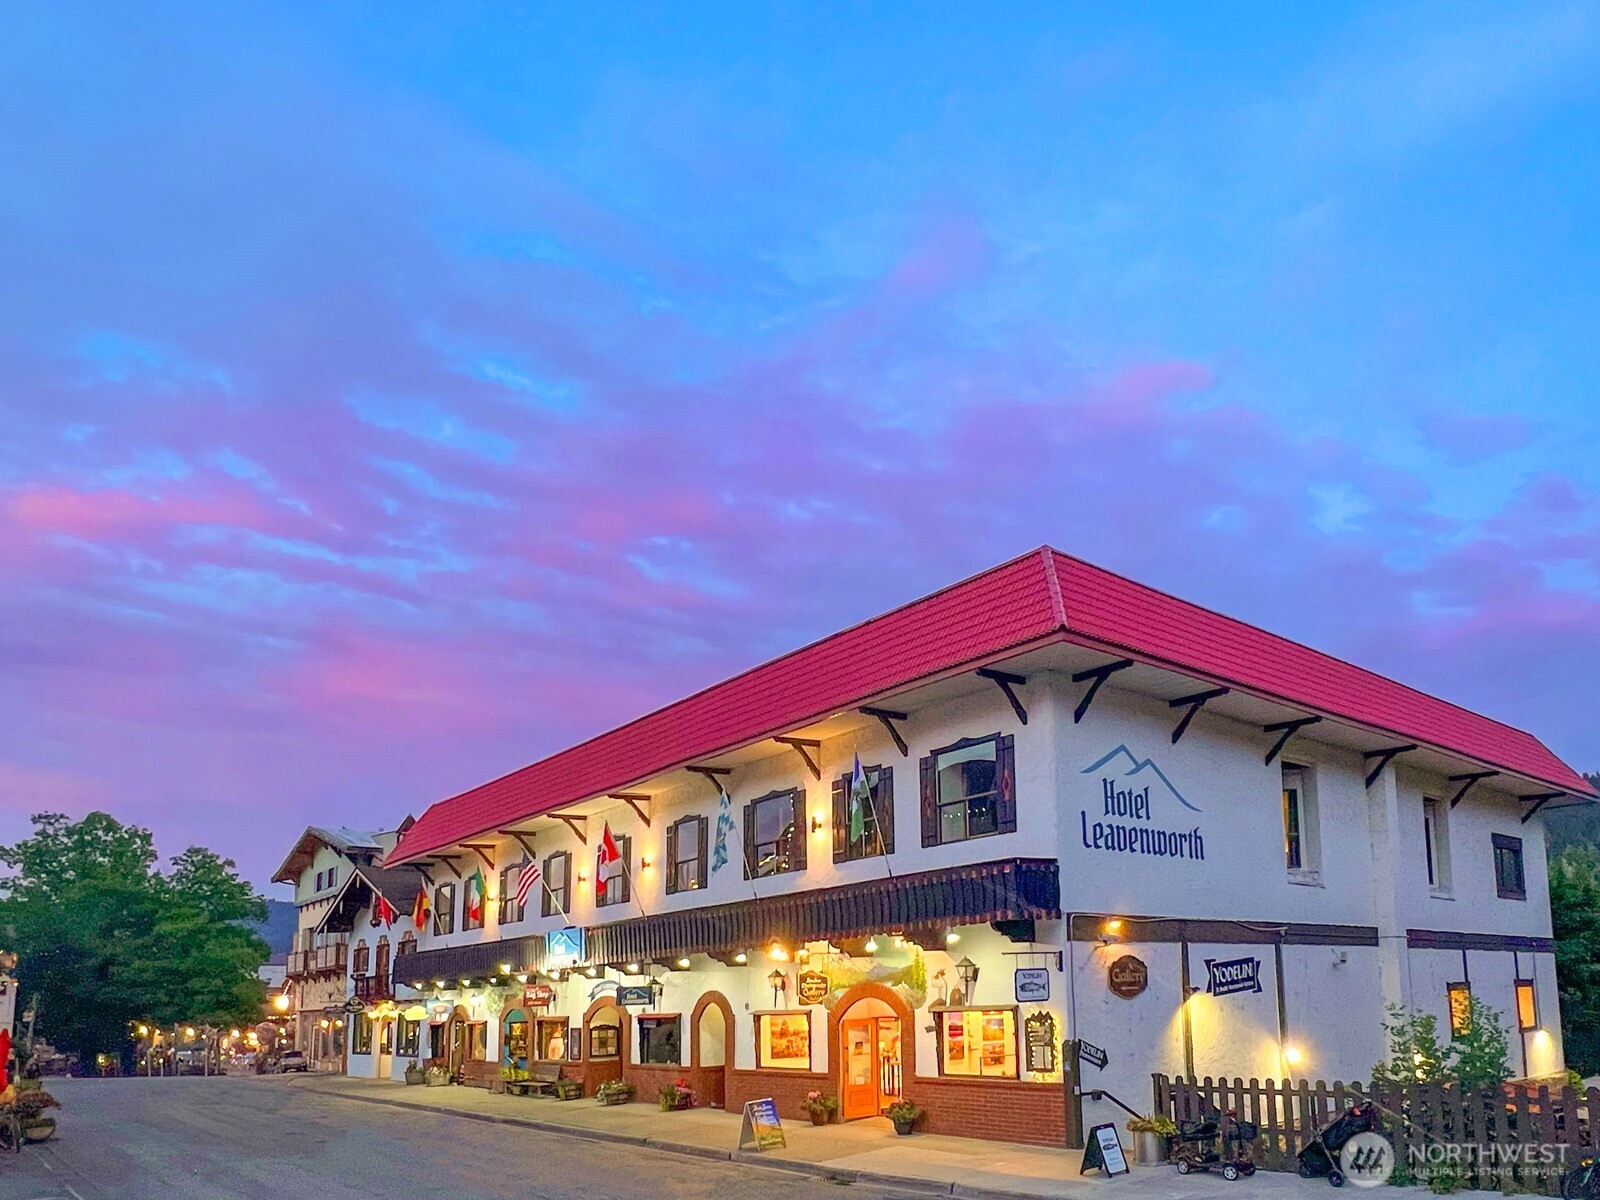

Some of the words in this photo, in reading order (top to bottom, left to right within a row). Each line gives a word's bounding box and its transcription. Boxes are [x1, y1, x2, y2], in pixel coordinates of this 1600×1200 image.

[1102, 778, 1150, 820] Hotel
[1081, 810, 1205, 860] Leavenworth
[1112, 968, 1145, 984] Gallery
[1213, 962, 1253, 984] YODELIN
